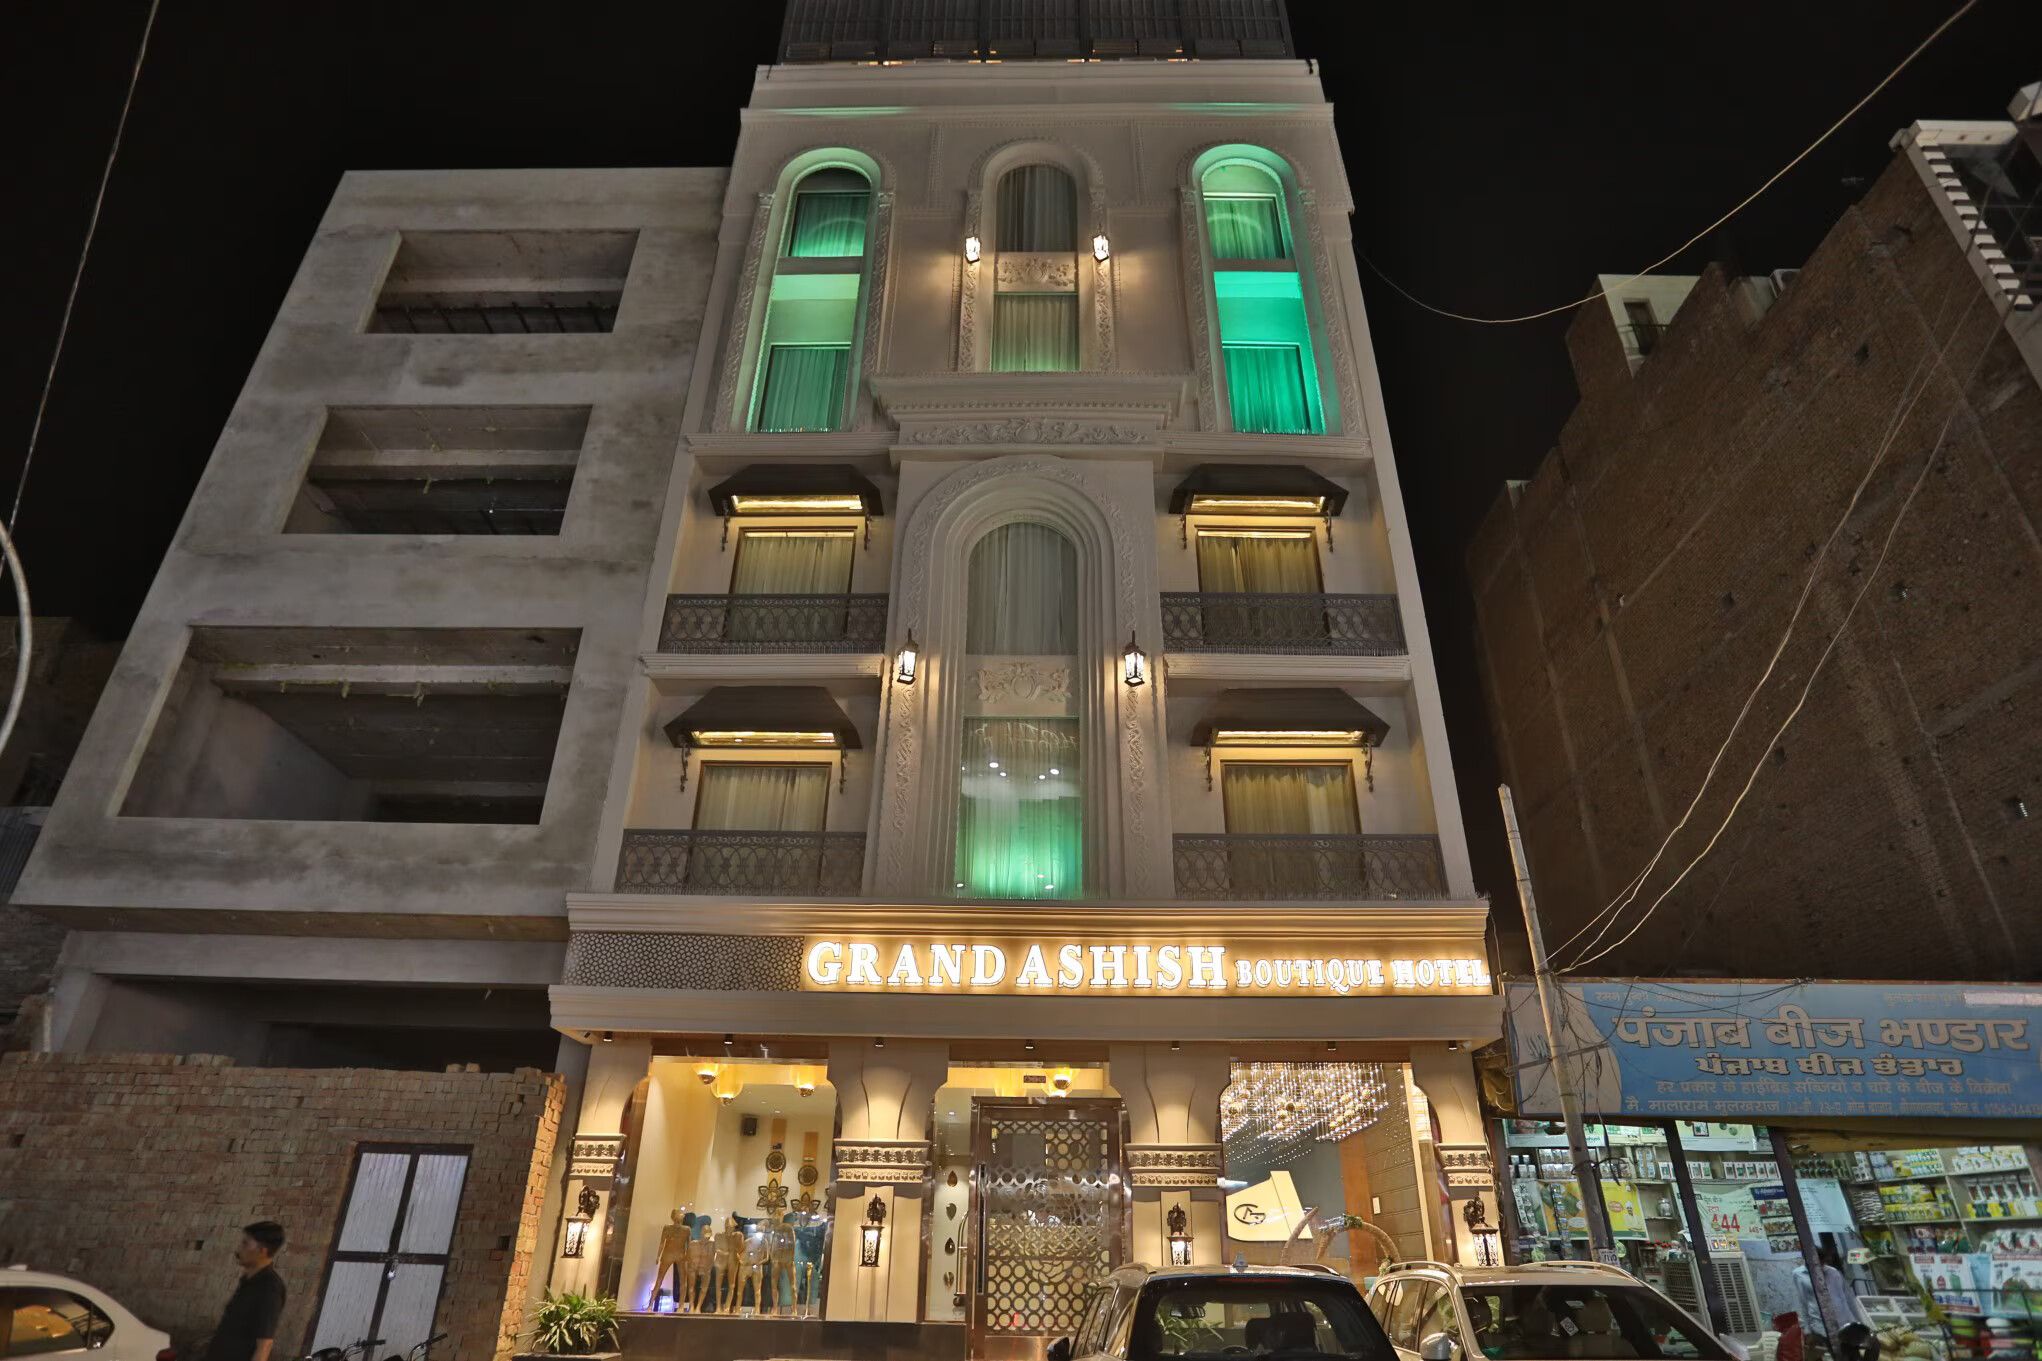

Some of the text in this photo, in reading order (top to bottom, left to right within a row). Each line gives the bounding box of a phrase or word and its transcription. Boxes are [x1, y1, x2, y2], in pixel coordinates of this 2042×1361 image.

[807, 941, 1491, 993] GRAND ASHISH BOUTIQUE HOTEL
[1611, 1003, 2030, 1053] पंजाब बीज भण्डार
[1695, 1051, 1964, 1077] ਪੰਜਾਬ ਬੀਜ ਭੰਡਾਰ
[1656, 1081, 1675, 1093] हर
[1680, 1081, 1717, 1095] प्रकार
[1723, 1079, 1737, 1093] के
[1897, 1077, 1911, 1094] के
[1949, 1078, 1963, 1094] के
[1648, 1099, 1709, 1113] मालाराम
[1714, 1099, 1780, 1116] मुलखराज
